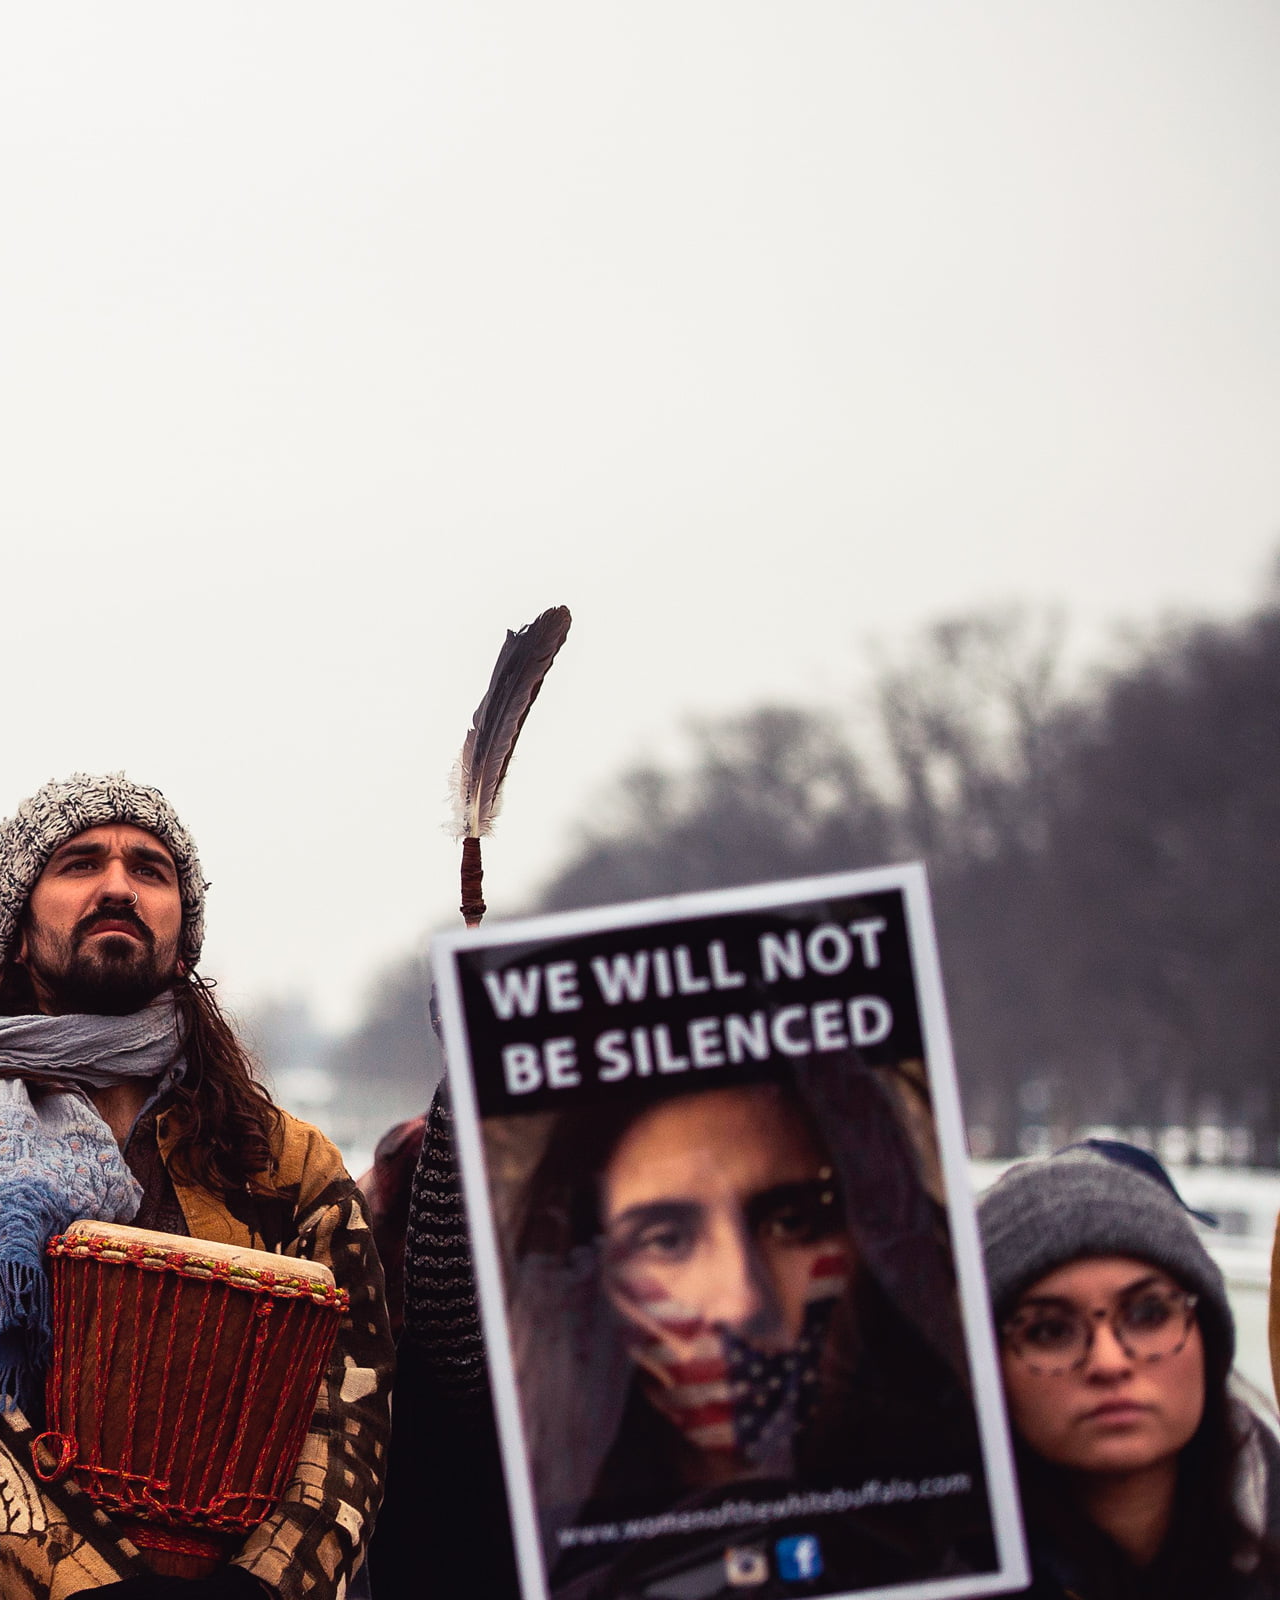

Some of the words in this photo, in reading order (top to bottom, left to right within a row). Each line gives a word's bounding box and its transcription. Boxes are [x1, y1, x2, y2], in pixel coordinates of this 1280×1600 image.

[483, 961, 581, 1020] WE
[591, 941, 746, 1005] WILL
[759, 917, 886, 982] NOT
[502, 1036, 580, 1095] BE
[595, 996, 893, 1081] SILENCED
[557, 1473, 972, 1546] www.womenofthewhitebuffalo.com
